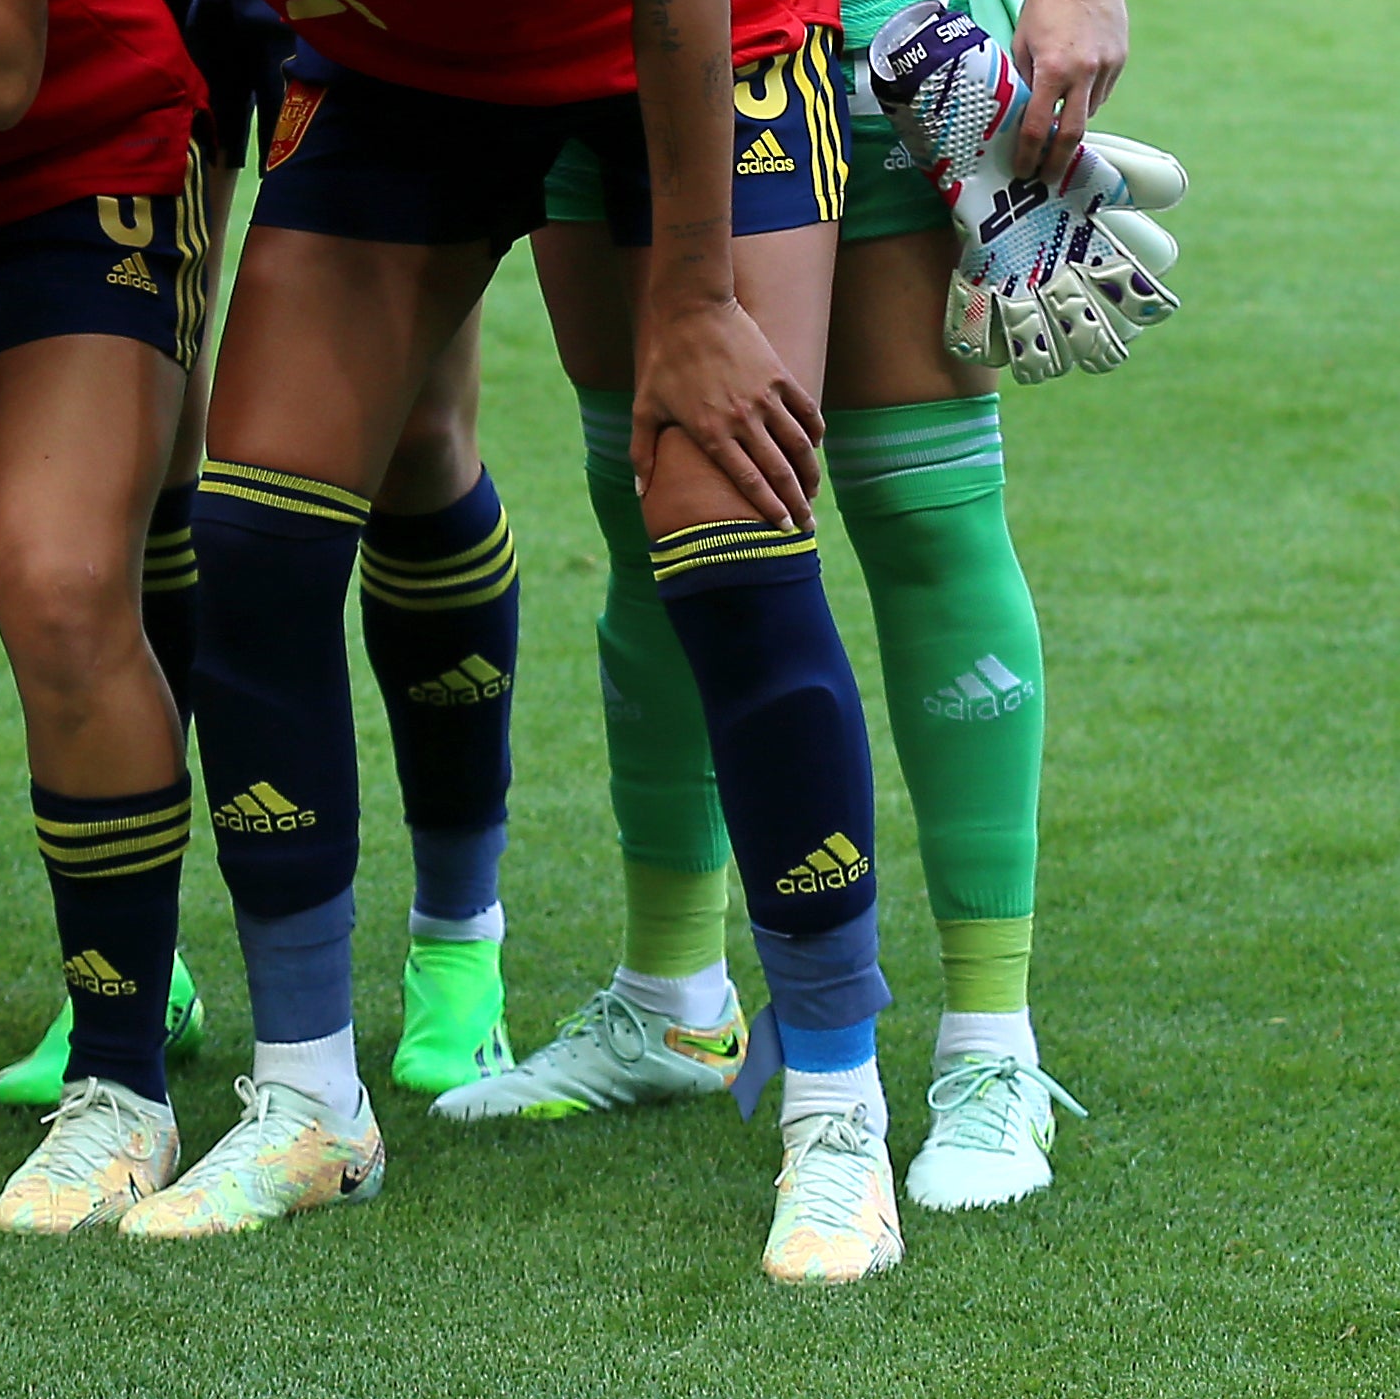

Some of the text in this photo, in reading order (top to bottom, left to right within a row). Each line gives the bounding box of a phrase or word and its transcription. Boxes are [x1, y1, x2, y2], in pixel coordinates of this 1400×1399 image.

[737, 156, 795, 175] adidas
[106, 270, 158, 294] adidas
[409, 673, 511, 706] adidas
[923, 680, 1035, 721] adidas
[213, 809, 316, 833] adidas
[776, 856, 869, 894] adidas
